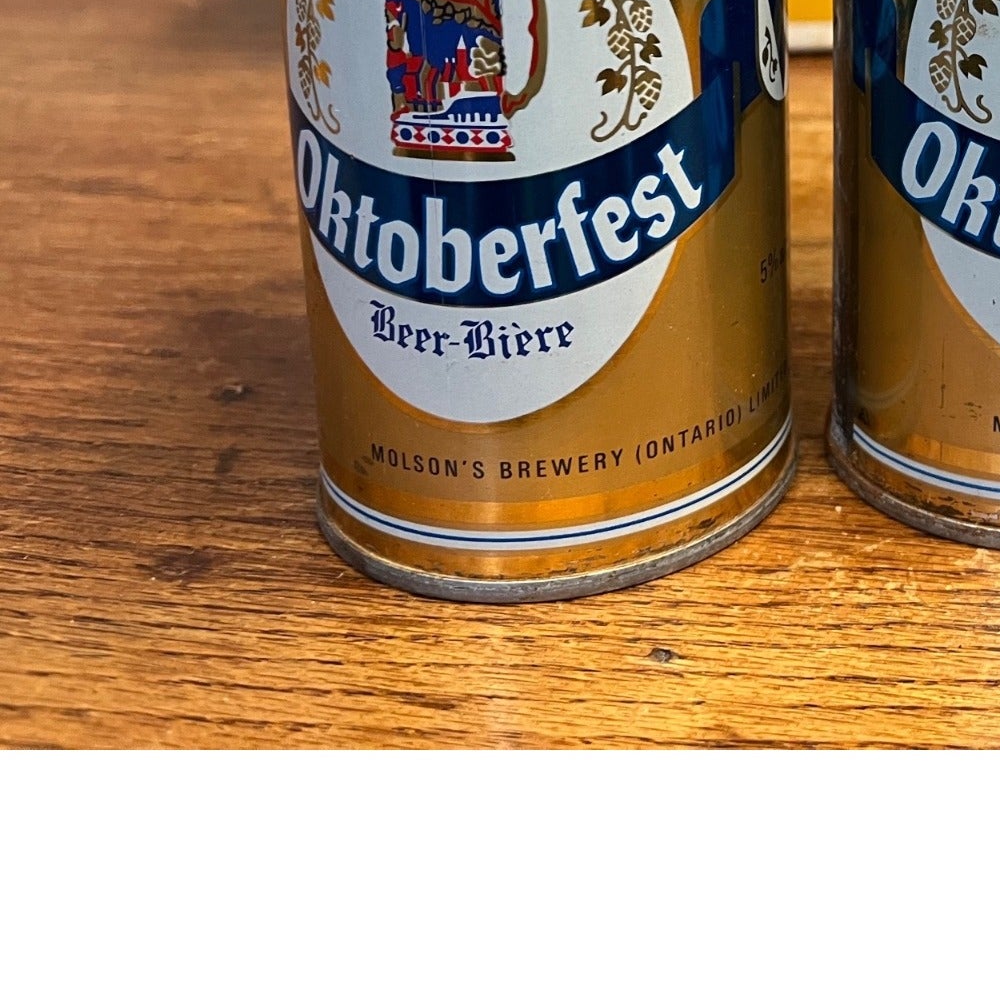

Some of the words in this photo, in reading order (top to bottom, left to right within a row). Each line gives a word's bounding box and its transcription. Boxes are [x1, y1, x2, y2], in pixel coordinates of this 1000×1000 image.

[296, 128, 704, 295] Oktoberfest
[369, 299, 575, 360] Beer-Bière
[371, 442, 485, 480] MOLSON'S
[500, 447, 624, 480] BREWERY
[635, 404, 742, 466] (ONTARIO)
